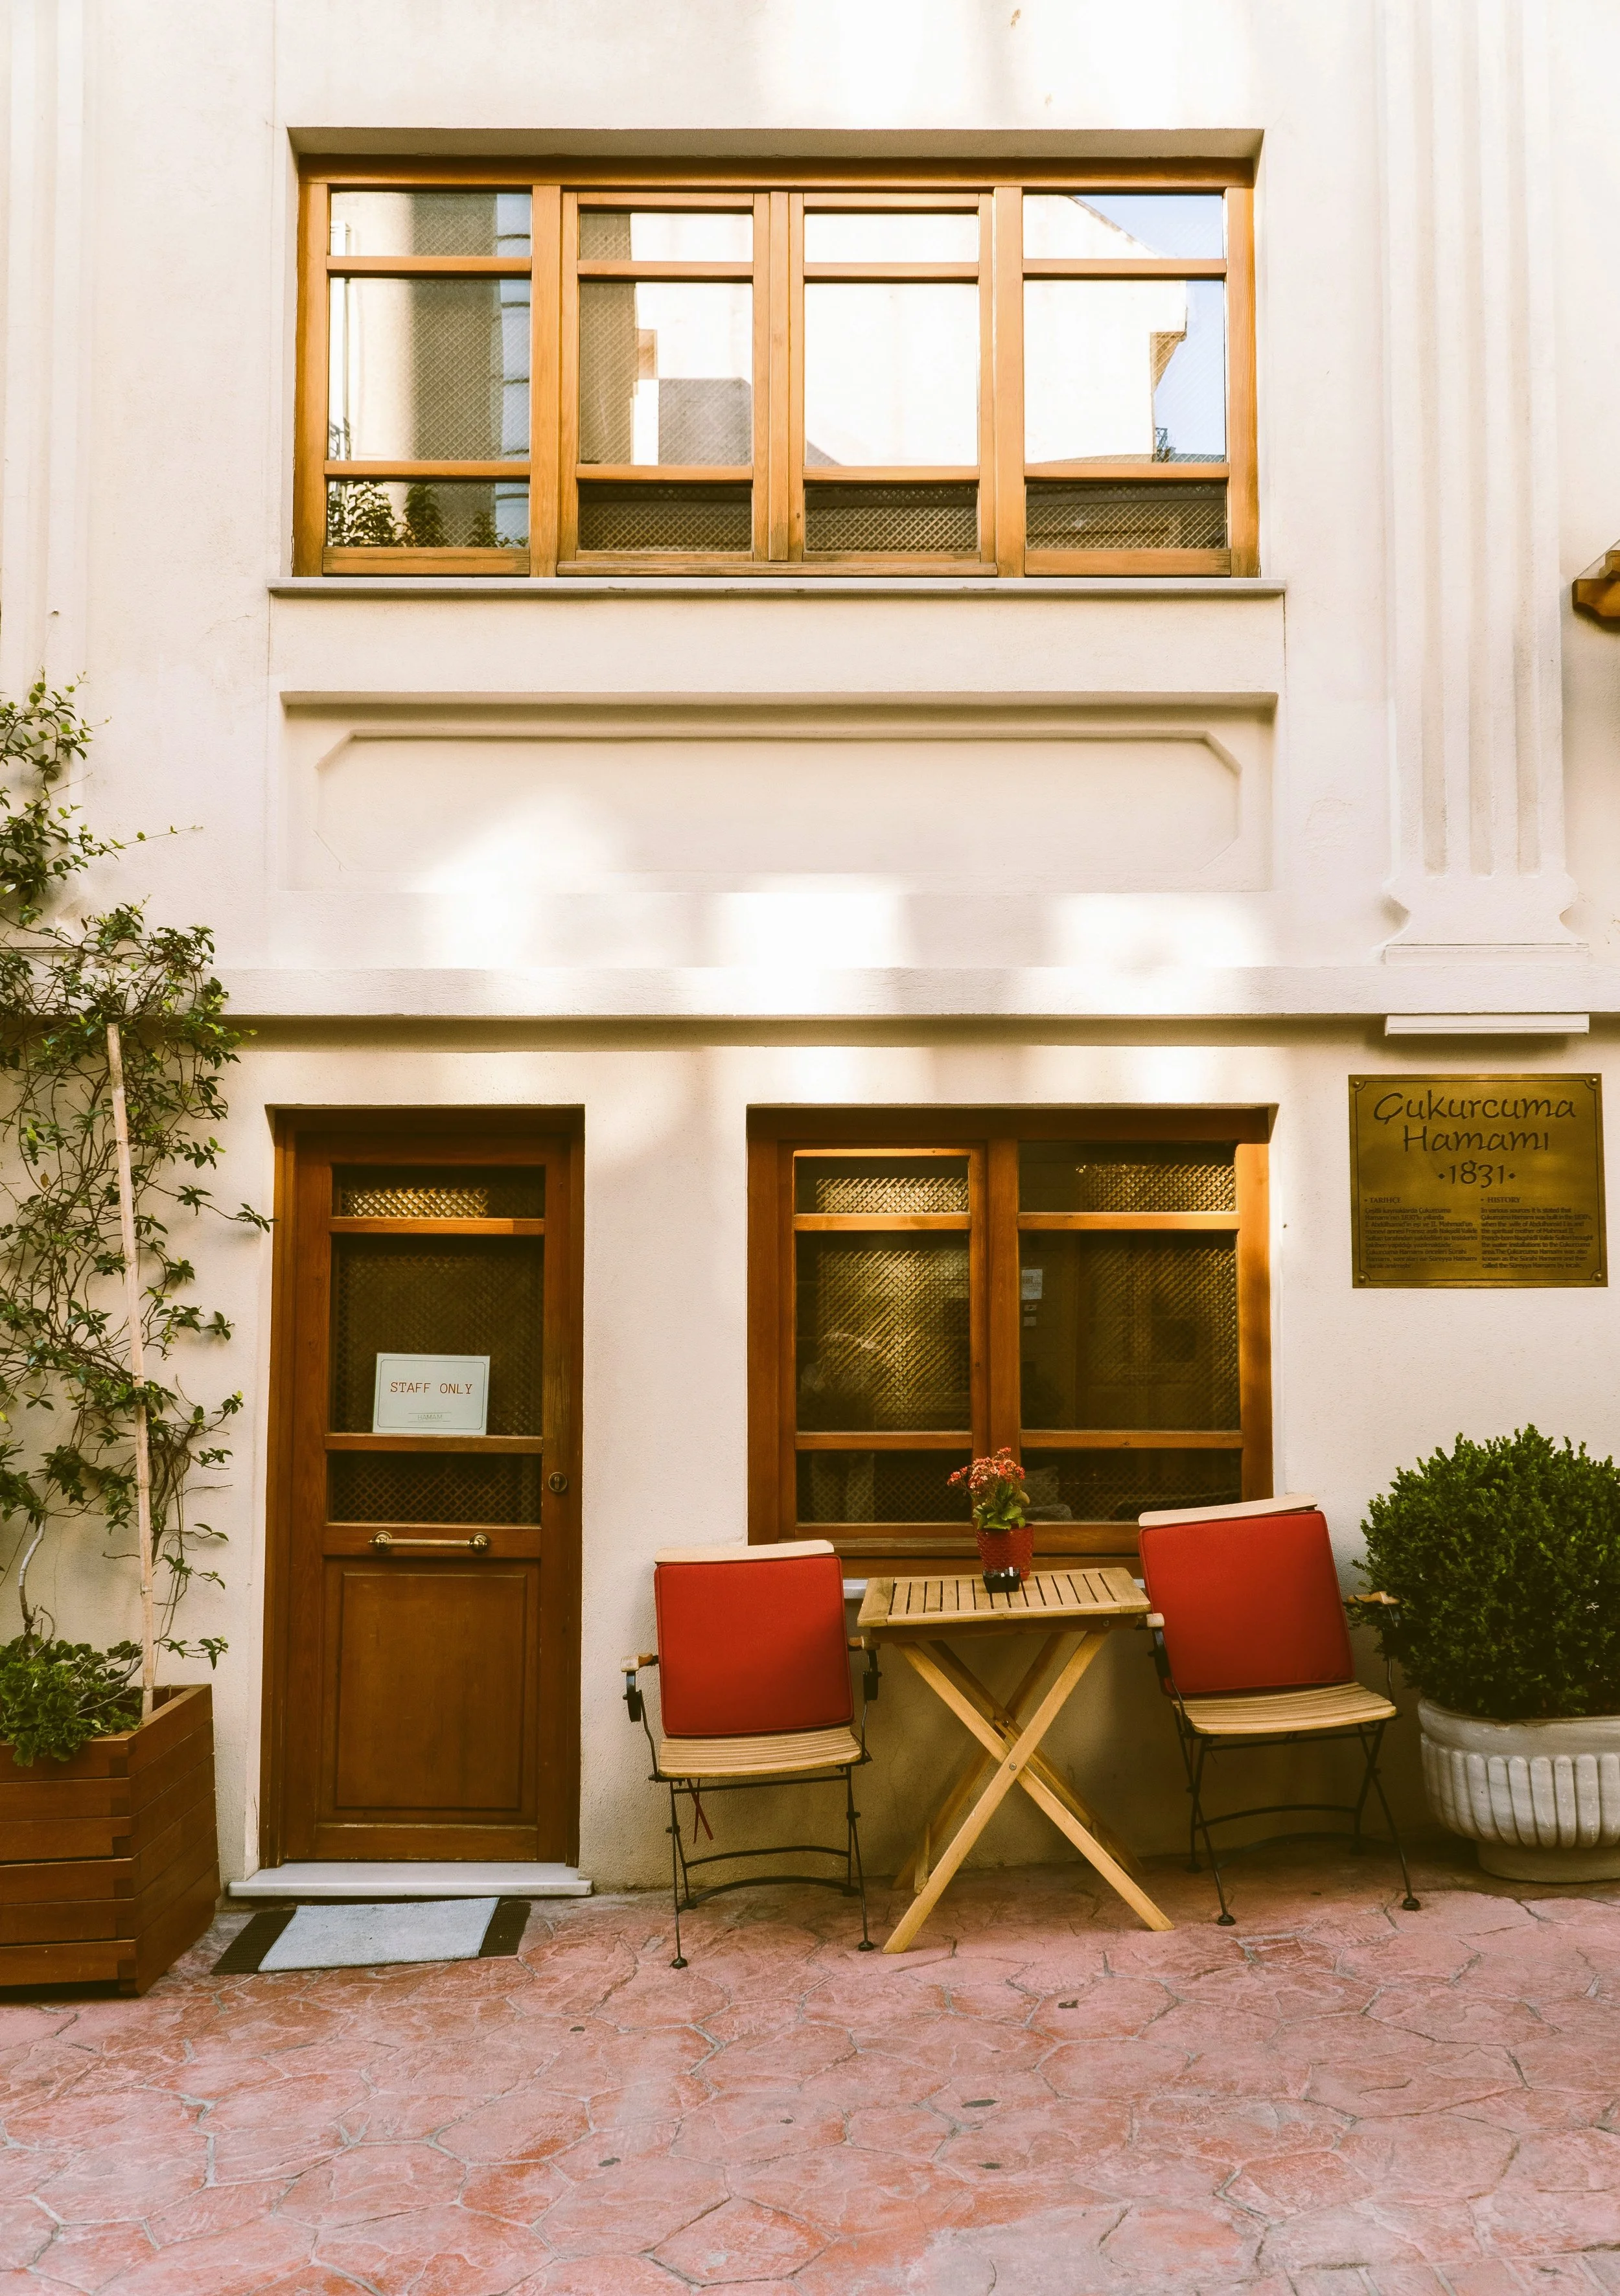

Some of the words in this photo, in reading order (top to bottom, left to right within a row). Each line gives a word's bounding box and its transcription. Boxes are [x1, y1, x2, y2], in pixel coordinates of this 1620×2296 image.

[1373, 1089, 1577, 1125] Çukurcuma
[1403, 1124, 1549, 1153] Hamamı
[389, 1381, 432, 1394] STAFF
[439, 1383, 474, 1395] ONLY
